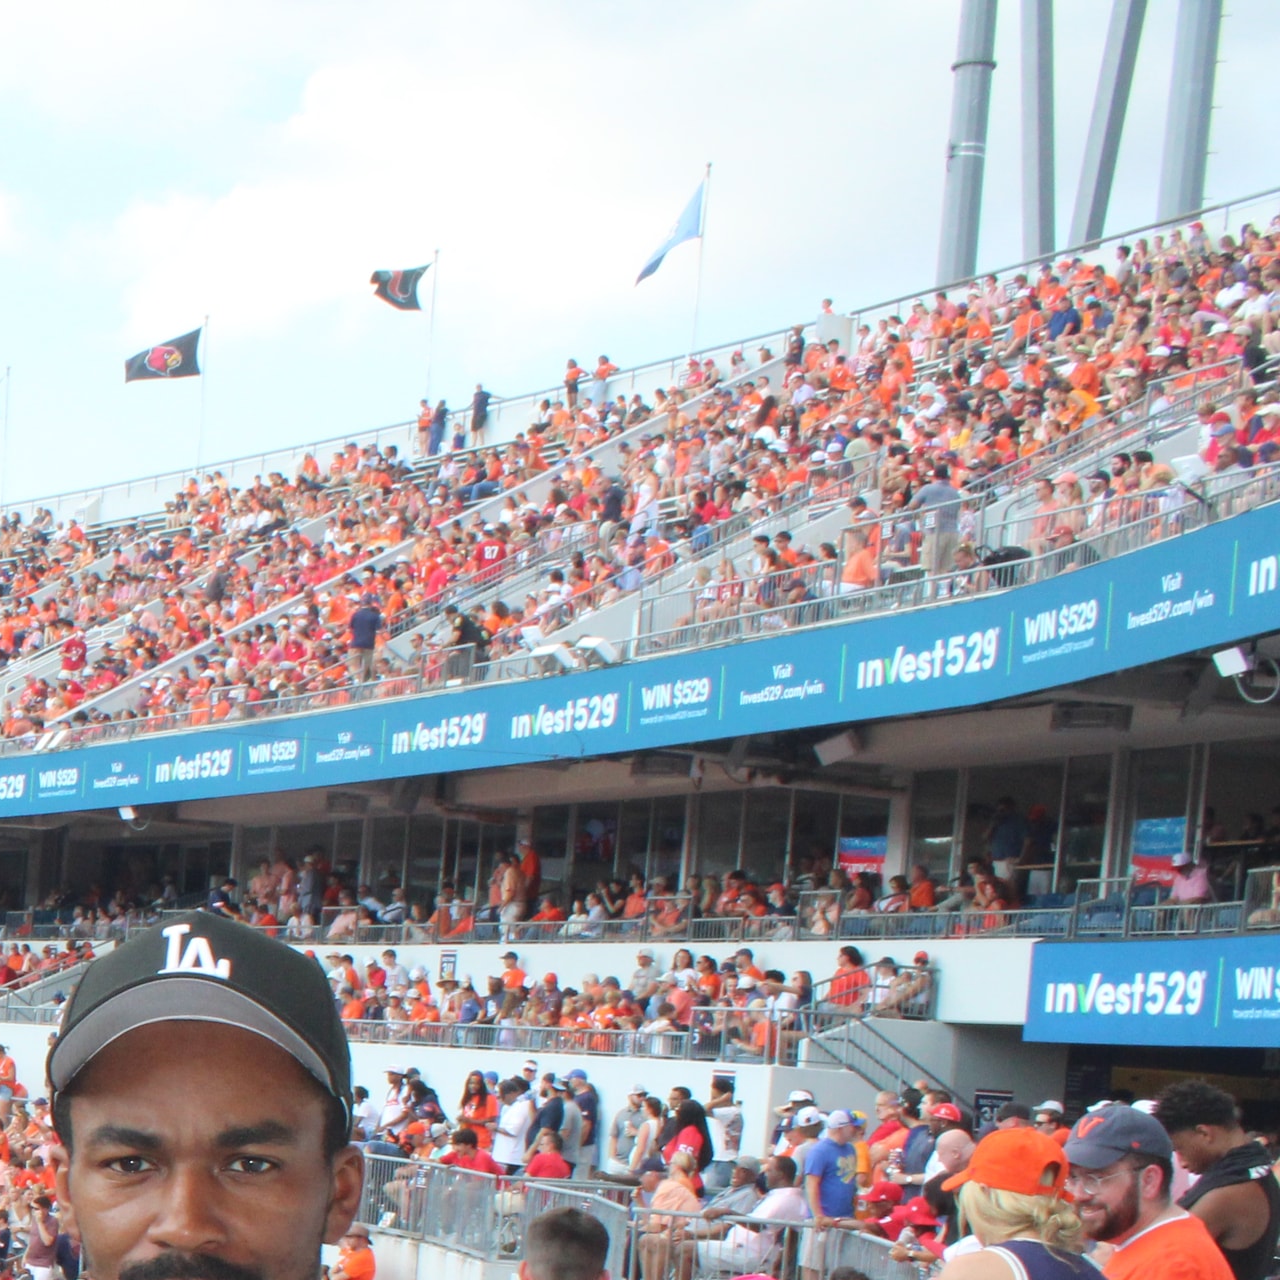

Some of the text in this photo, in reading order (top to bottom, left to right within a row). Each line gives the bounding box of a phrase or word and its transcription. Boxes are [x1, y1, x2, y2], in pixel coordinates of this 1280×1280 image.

[1162, 571, 1183, 593] Visit
[1024, 598, 1098, 646] WIN $529
[773, 663, 793, 680] Visit
[857, 627, 1000, 689] invest529
[642, 678, 710, 711] WIN $529
[511, 692, 619, 739] invest529
[392, 712, 487, 754] invest529
[155, 749, 232, 783] invest529
[249, 739, 298, 765] WIN $529
[39, 768, 77, 788] WIN $529
[157, 924, 231, 980] LA
[1045, 971, 1206, 1015] invest529
[1235, 966, 1273, 1000] WIN
[1077, 1116, 1105, 1139] V
